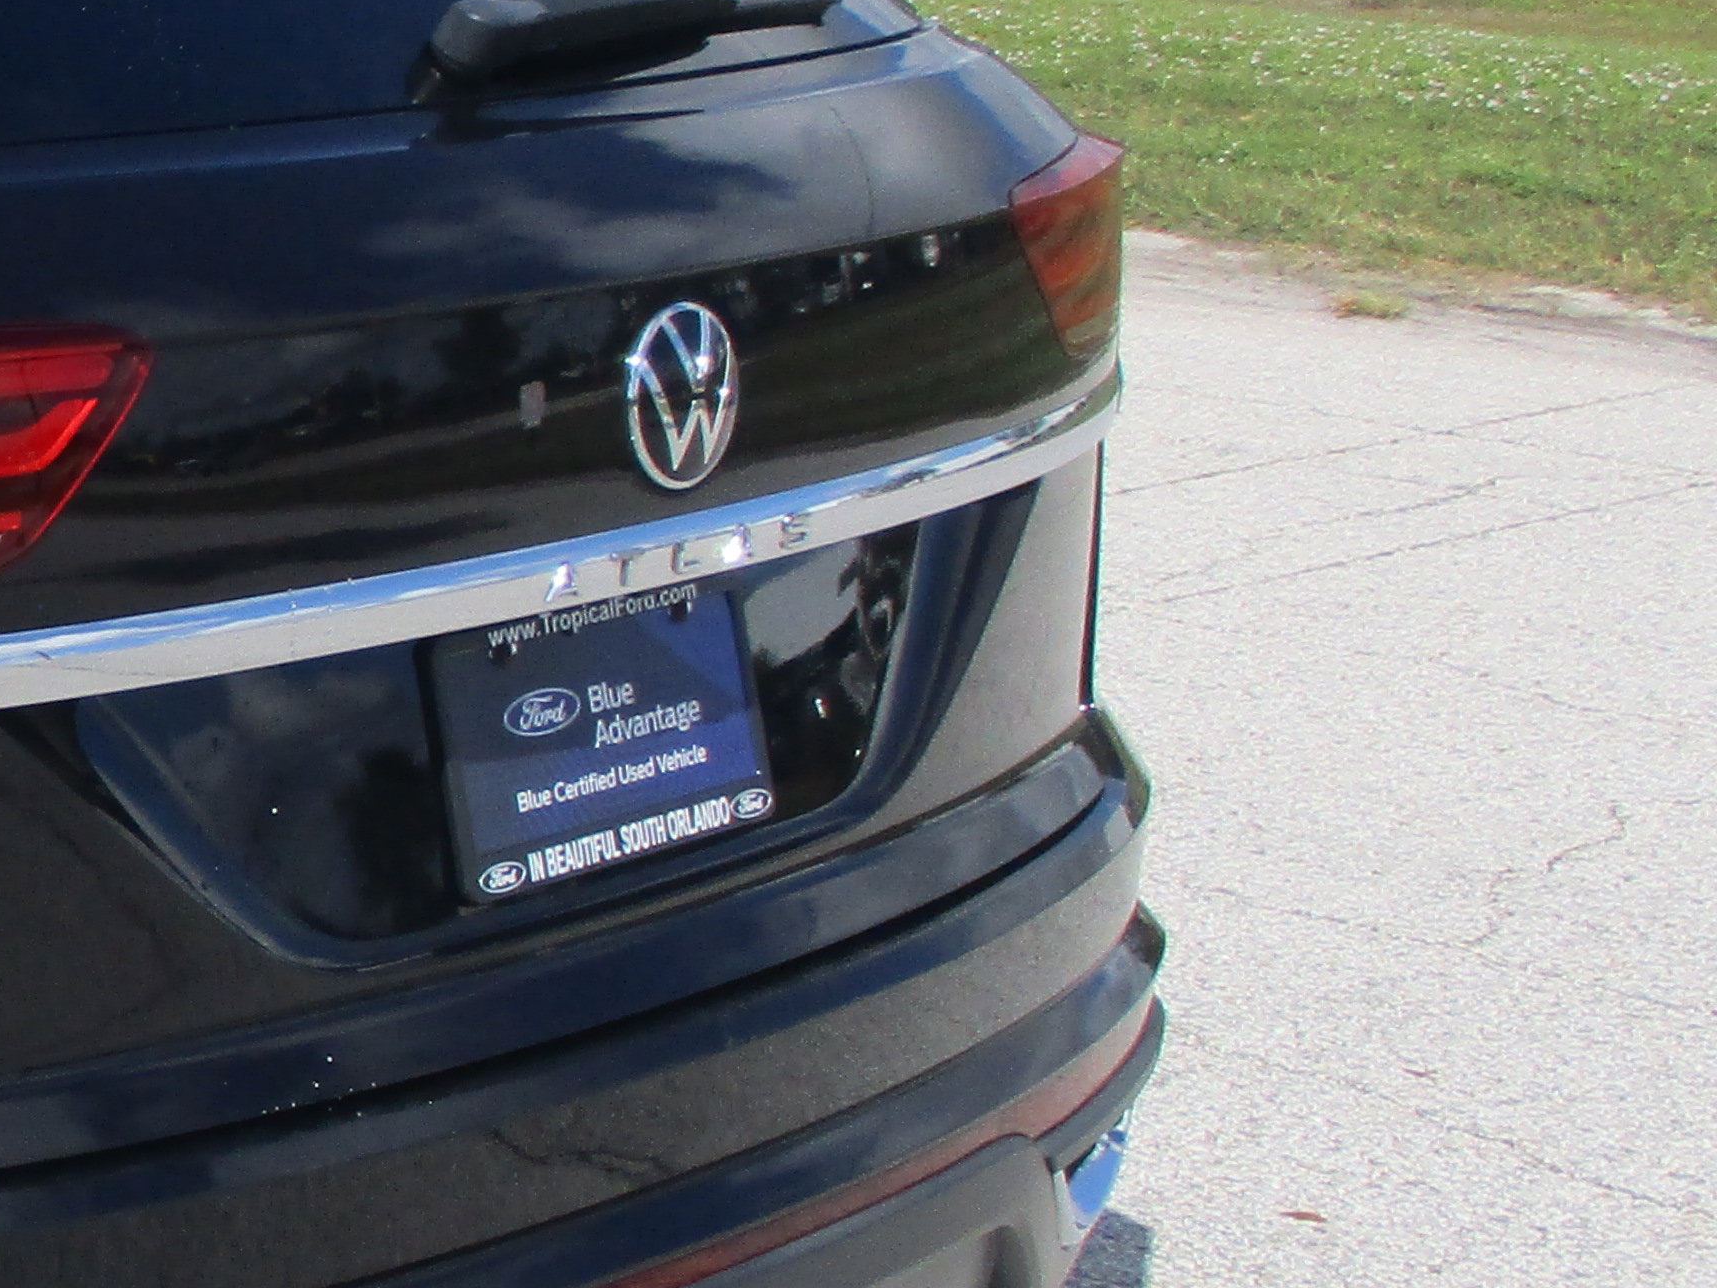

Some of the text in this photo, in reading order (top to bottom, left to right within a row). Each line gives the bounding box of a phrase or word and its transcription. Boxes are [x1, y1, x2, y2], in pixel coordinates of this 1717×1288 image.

[487, 583, 697, 647] www.TropicalFord.com
[519, 695, 567, 730] Ford
[587, 681, 636, 713] Blue
[595, 698, 702, 748] Advantage
[516, 744, 708, 813] Blue Certified Used Vehicle
[527, 796, 732, 882] IN BEAUTIFUL SOUTH ORLANDO
